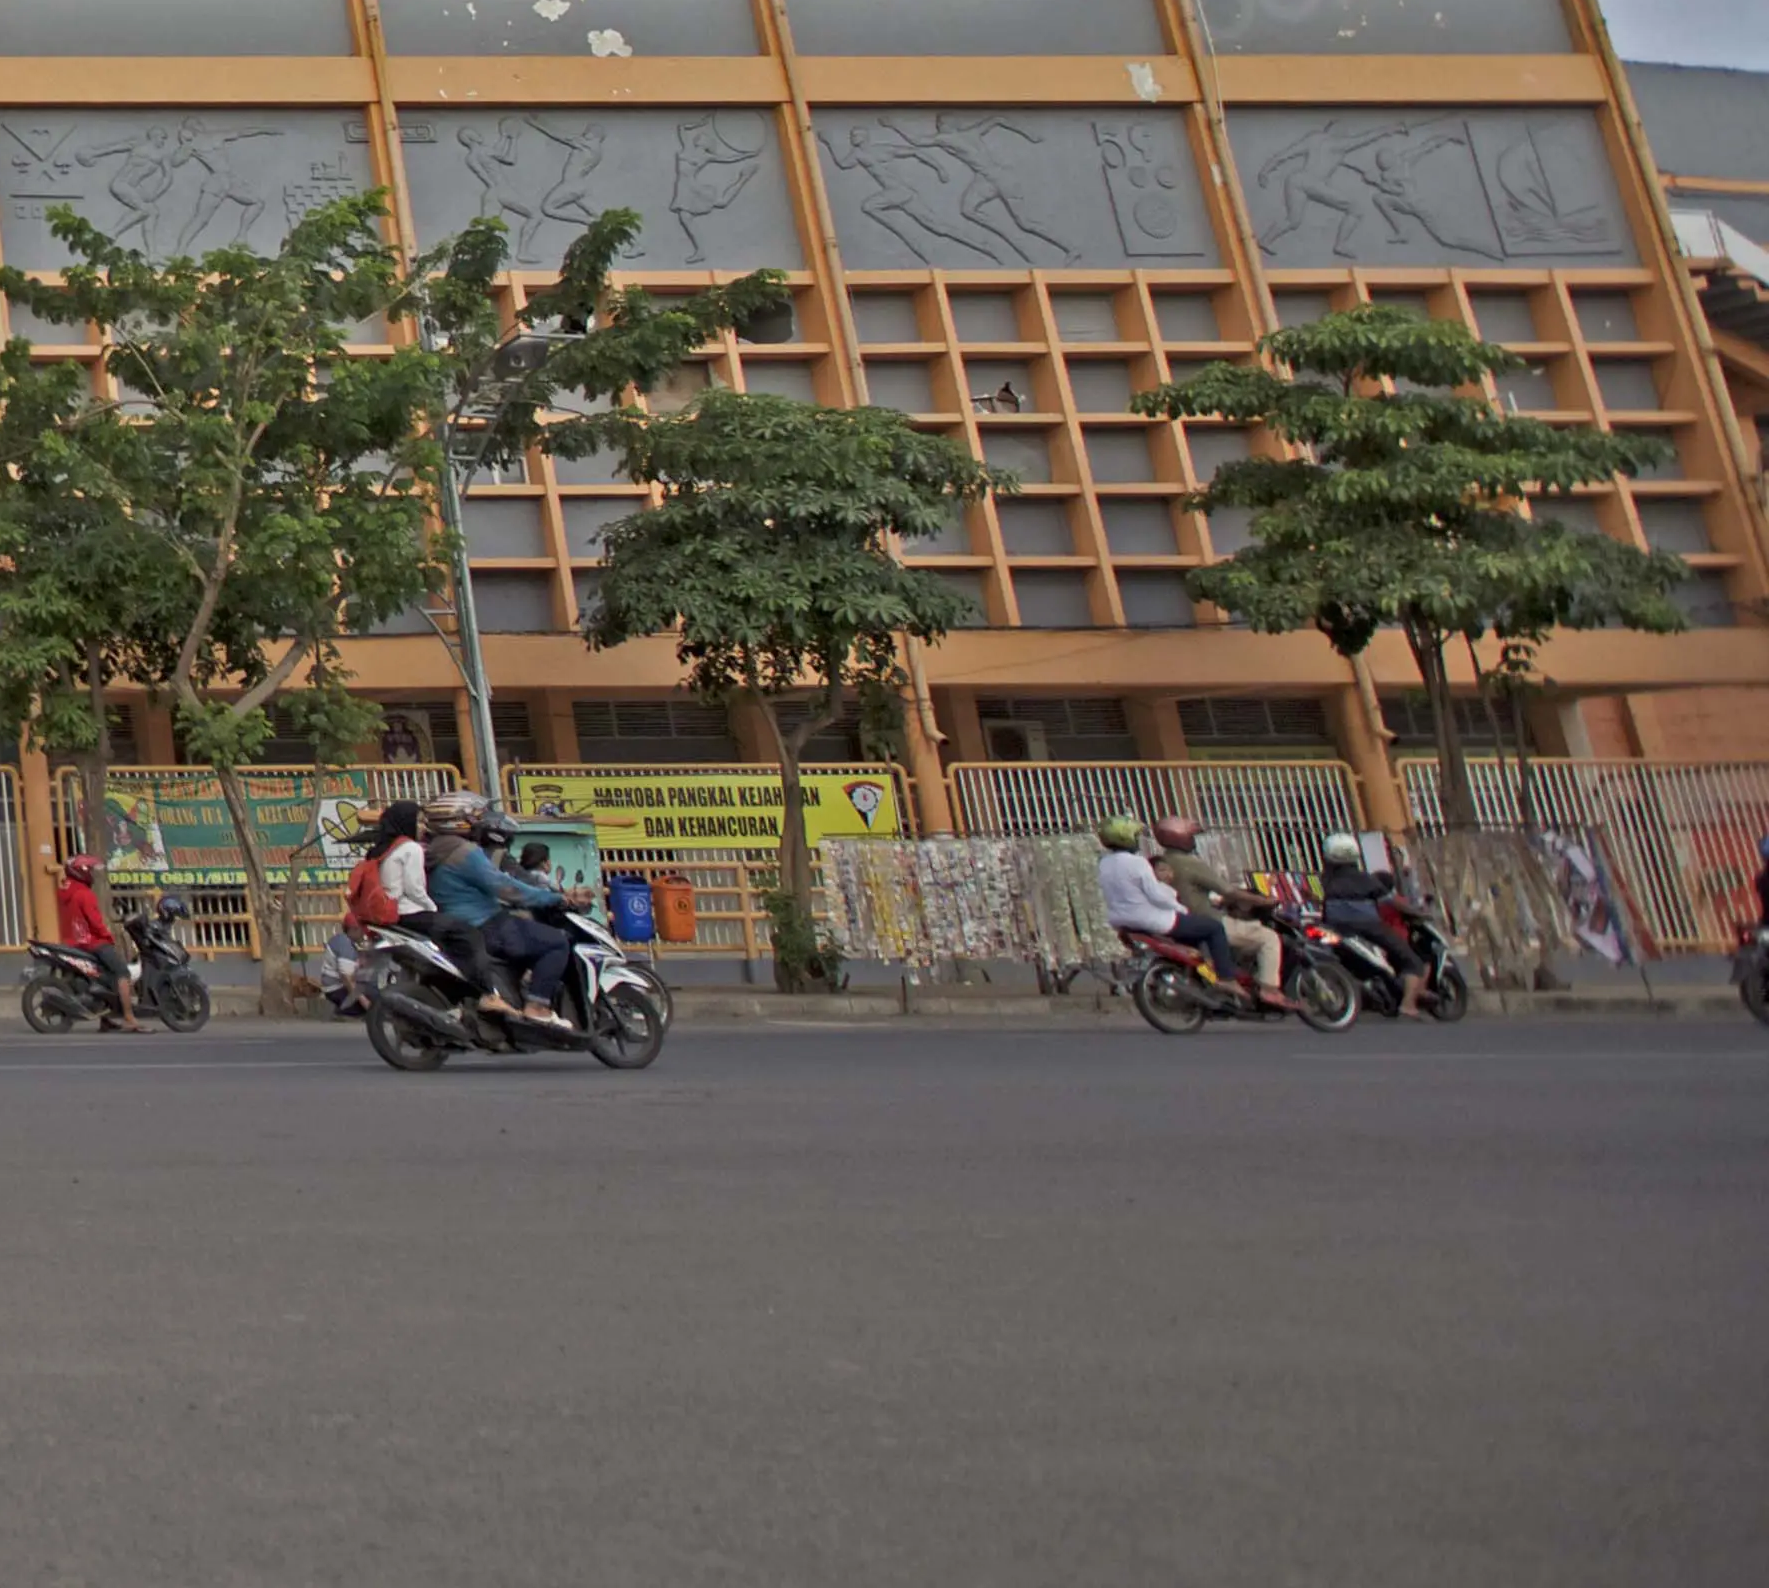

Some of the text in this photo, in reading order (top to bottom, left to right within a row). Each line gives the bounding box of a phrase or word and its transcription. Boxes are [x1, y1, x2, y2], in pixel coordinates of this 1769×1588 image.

[594, 785, 820, 808] NARKOBA PANGKAL KEJAHAN
[643, 815, 780, 838] DAN KEHANCURAN
[108, 871, 154, 885] ODIM
